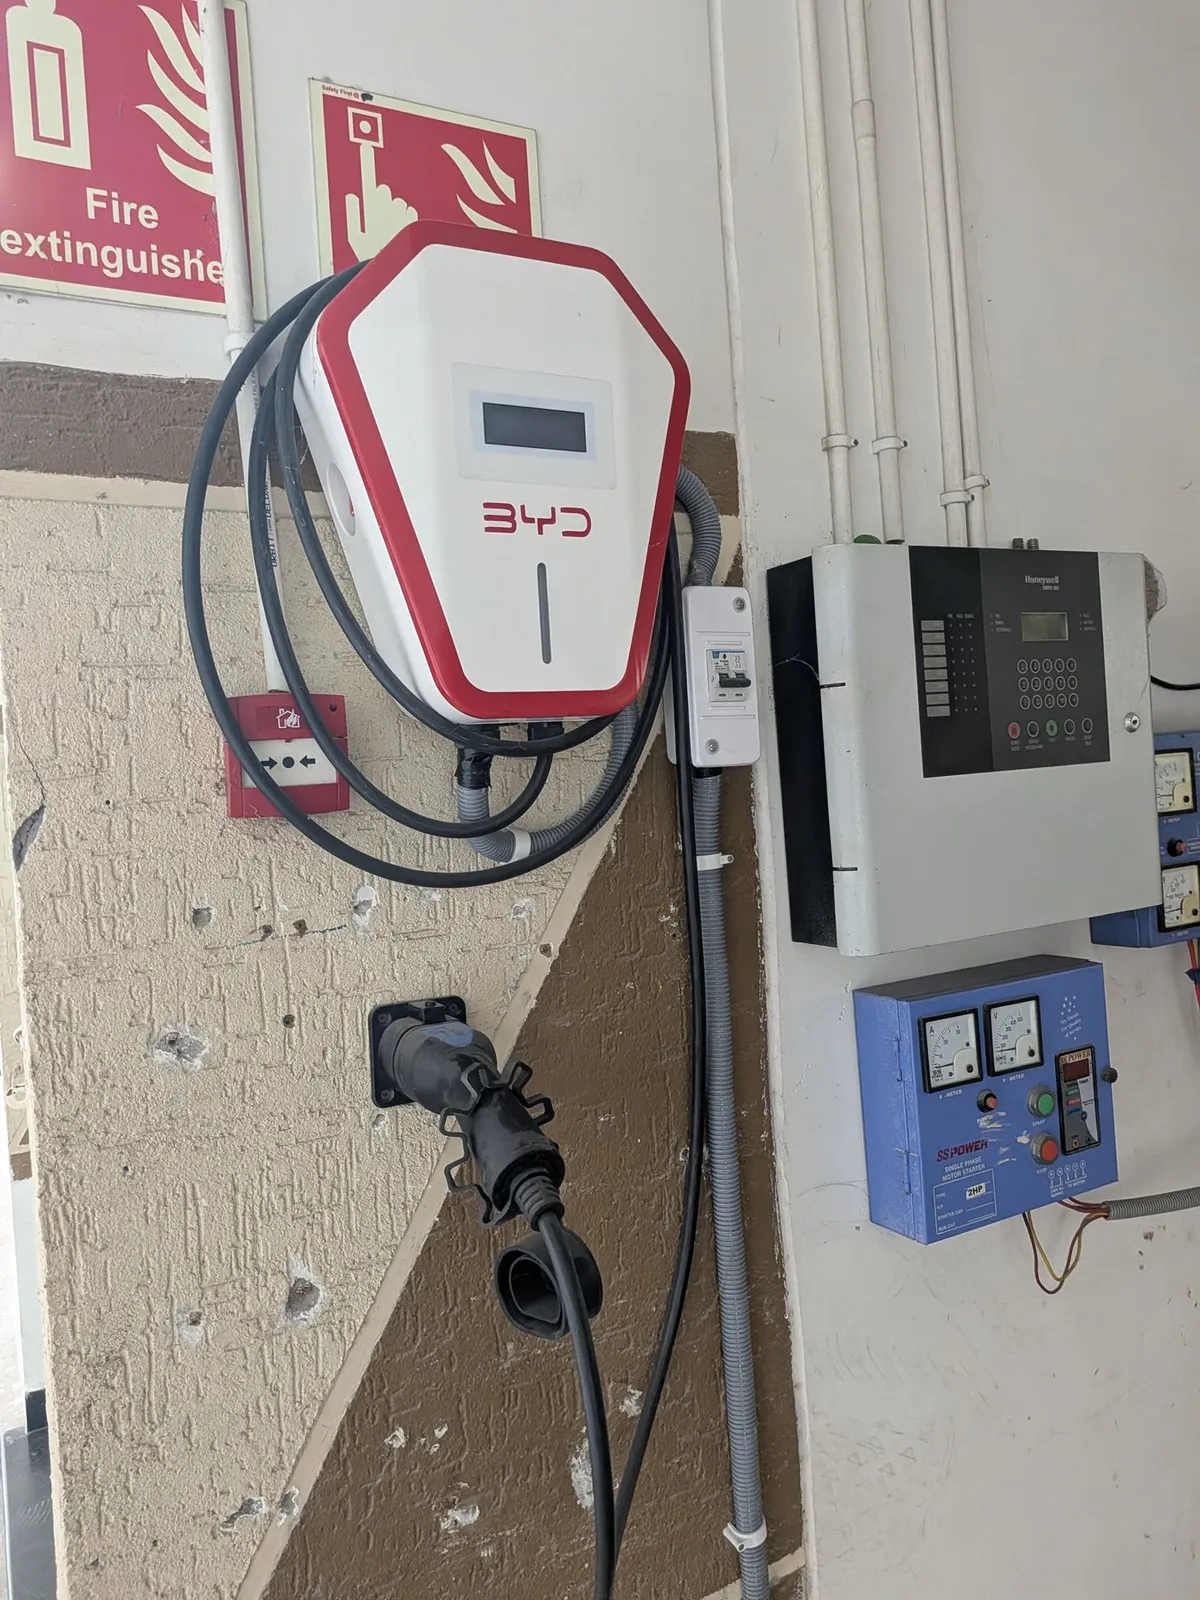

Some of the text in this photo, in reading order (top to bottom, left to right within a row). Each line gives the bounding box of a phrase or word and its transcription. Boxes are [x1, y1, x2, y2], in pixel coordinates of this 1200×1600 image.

[321, 84, 339, 94] Safety
[340, 88, 353, 97] First
[85, 187, 159, 229] Fire
[0, 228, 225, 287] extinguishe
[482, 501, 592, 538] BYD
[1024, 575, 1060, 585] Honeywell
[929, 1026, 935, 1034] A
[1068, 1049, 1091, 1063] POWER
[1010, 1073, 1025, 1082] METER
[946, 1089, 963, 1098] METER
[1032, 1119, 1046, 1127] START
[944, 1155, 982, 1173] SINGLE PHASE
[942, 1163, 986, 1181] MOTOR STARTER
[967, 1185, 983, 1197] 2HP
[937, 1210, 955, 1220] STARTER
